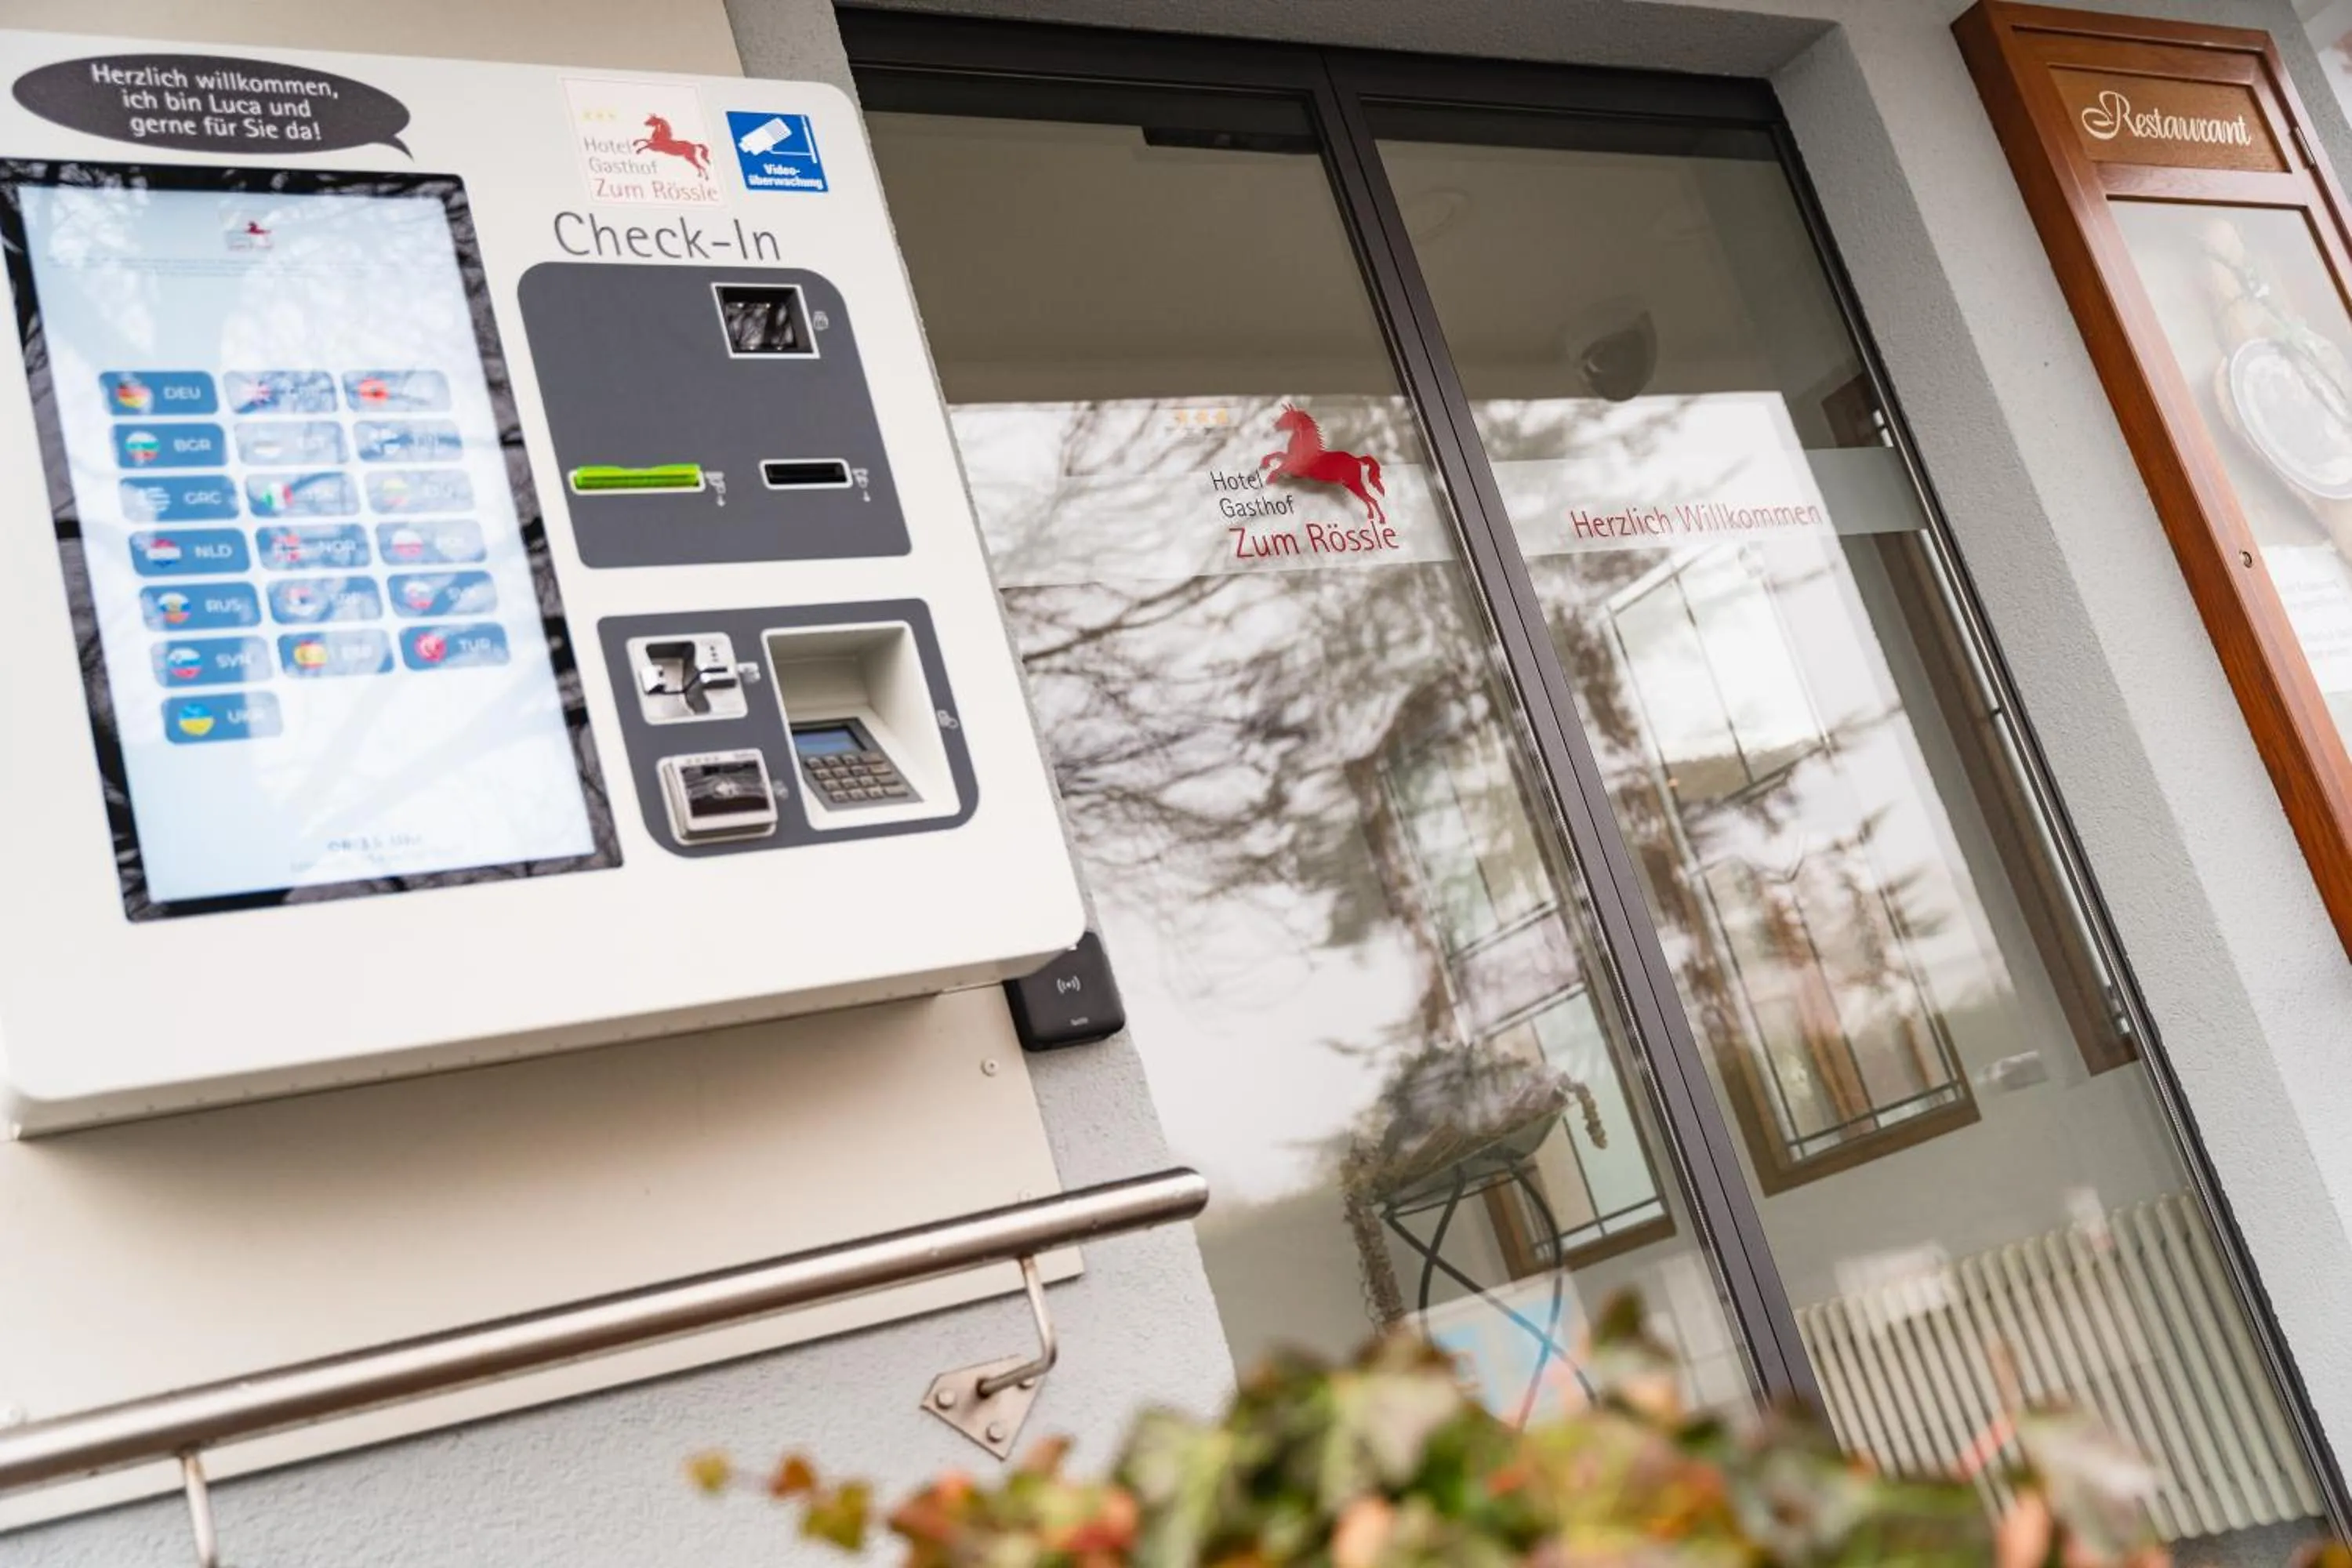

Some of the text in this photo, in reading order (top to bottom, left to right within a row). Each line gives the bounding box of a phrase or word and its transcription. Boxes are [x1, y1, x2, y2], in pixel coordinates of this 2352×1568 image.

[90, 63, 339, 100] Herzlich willkommen,
[122, 90, 312, 118] ich bin Luca und
[130, 116, 322, 141] gerne für Sie da!
[2082, 90, 2252, 146] Restaurant
[583, 137, 633, 154] Hotel
[589, 158, 659, 175] Gasthof
[593, 179, 719, 202] Zum Rössle
[554, 211, 781, 261] Check-In
[163, 385, 202, 401] DEU
[1210, 470, 1264, 492] Hotel
[1218, 495, 1294, 519] Gasthof
[1570, 503, 1824, 539] Herzlich Willkommen
[194, 543, 234, 558] NLD
[1229, 521, 1399, 559] Zum Rössle
